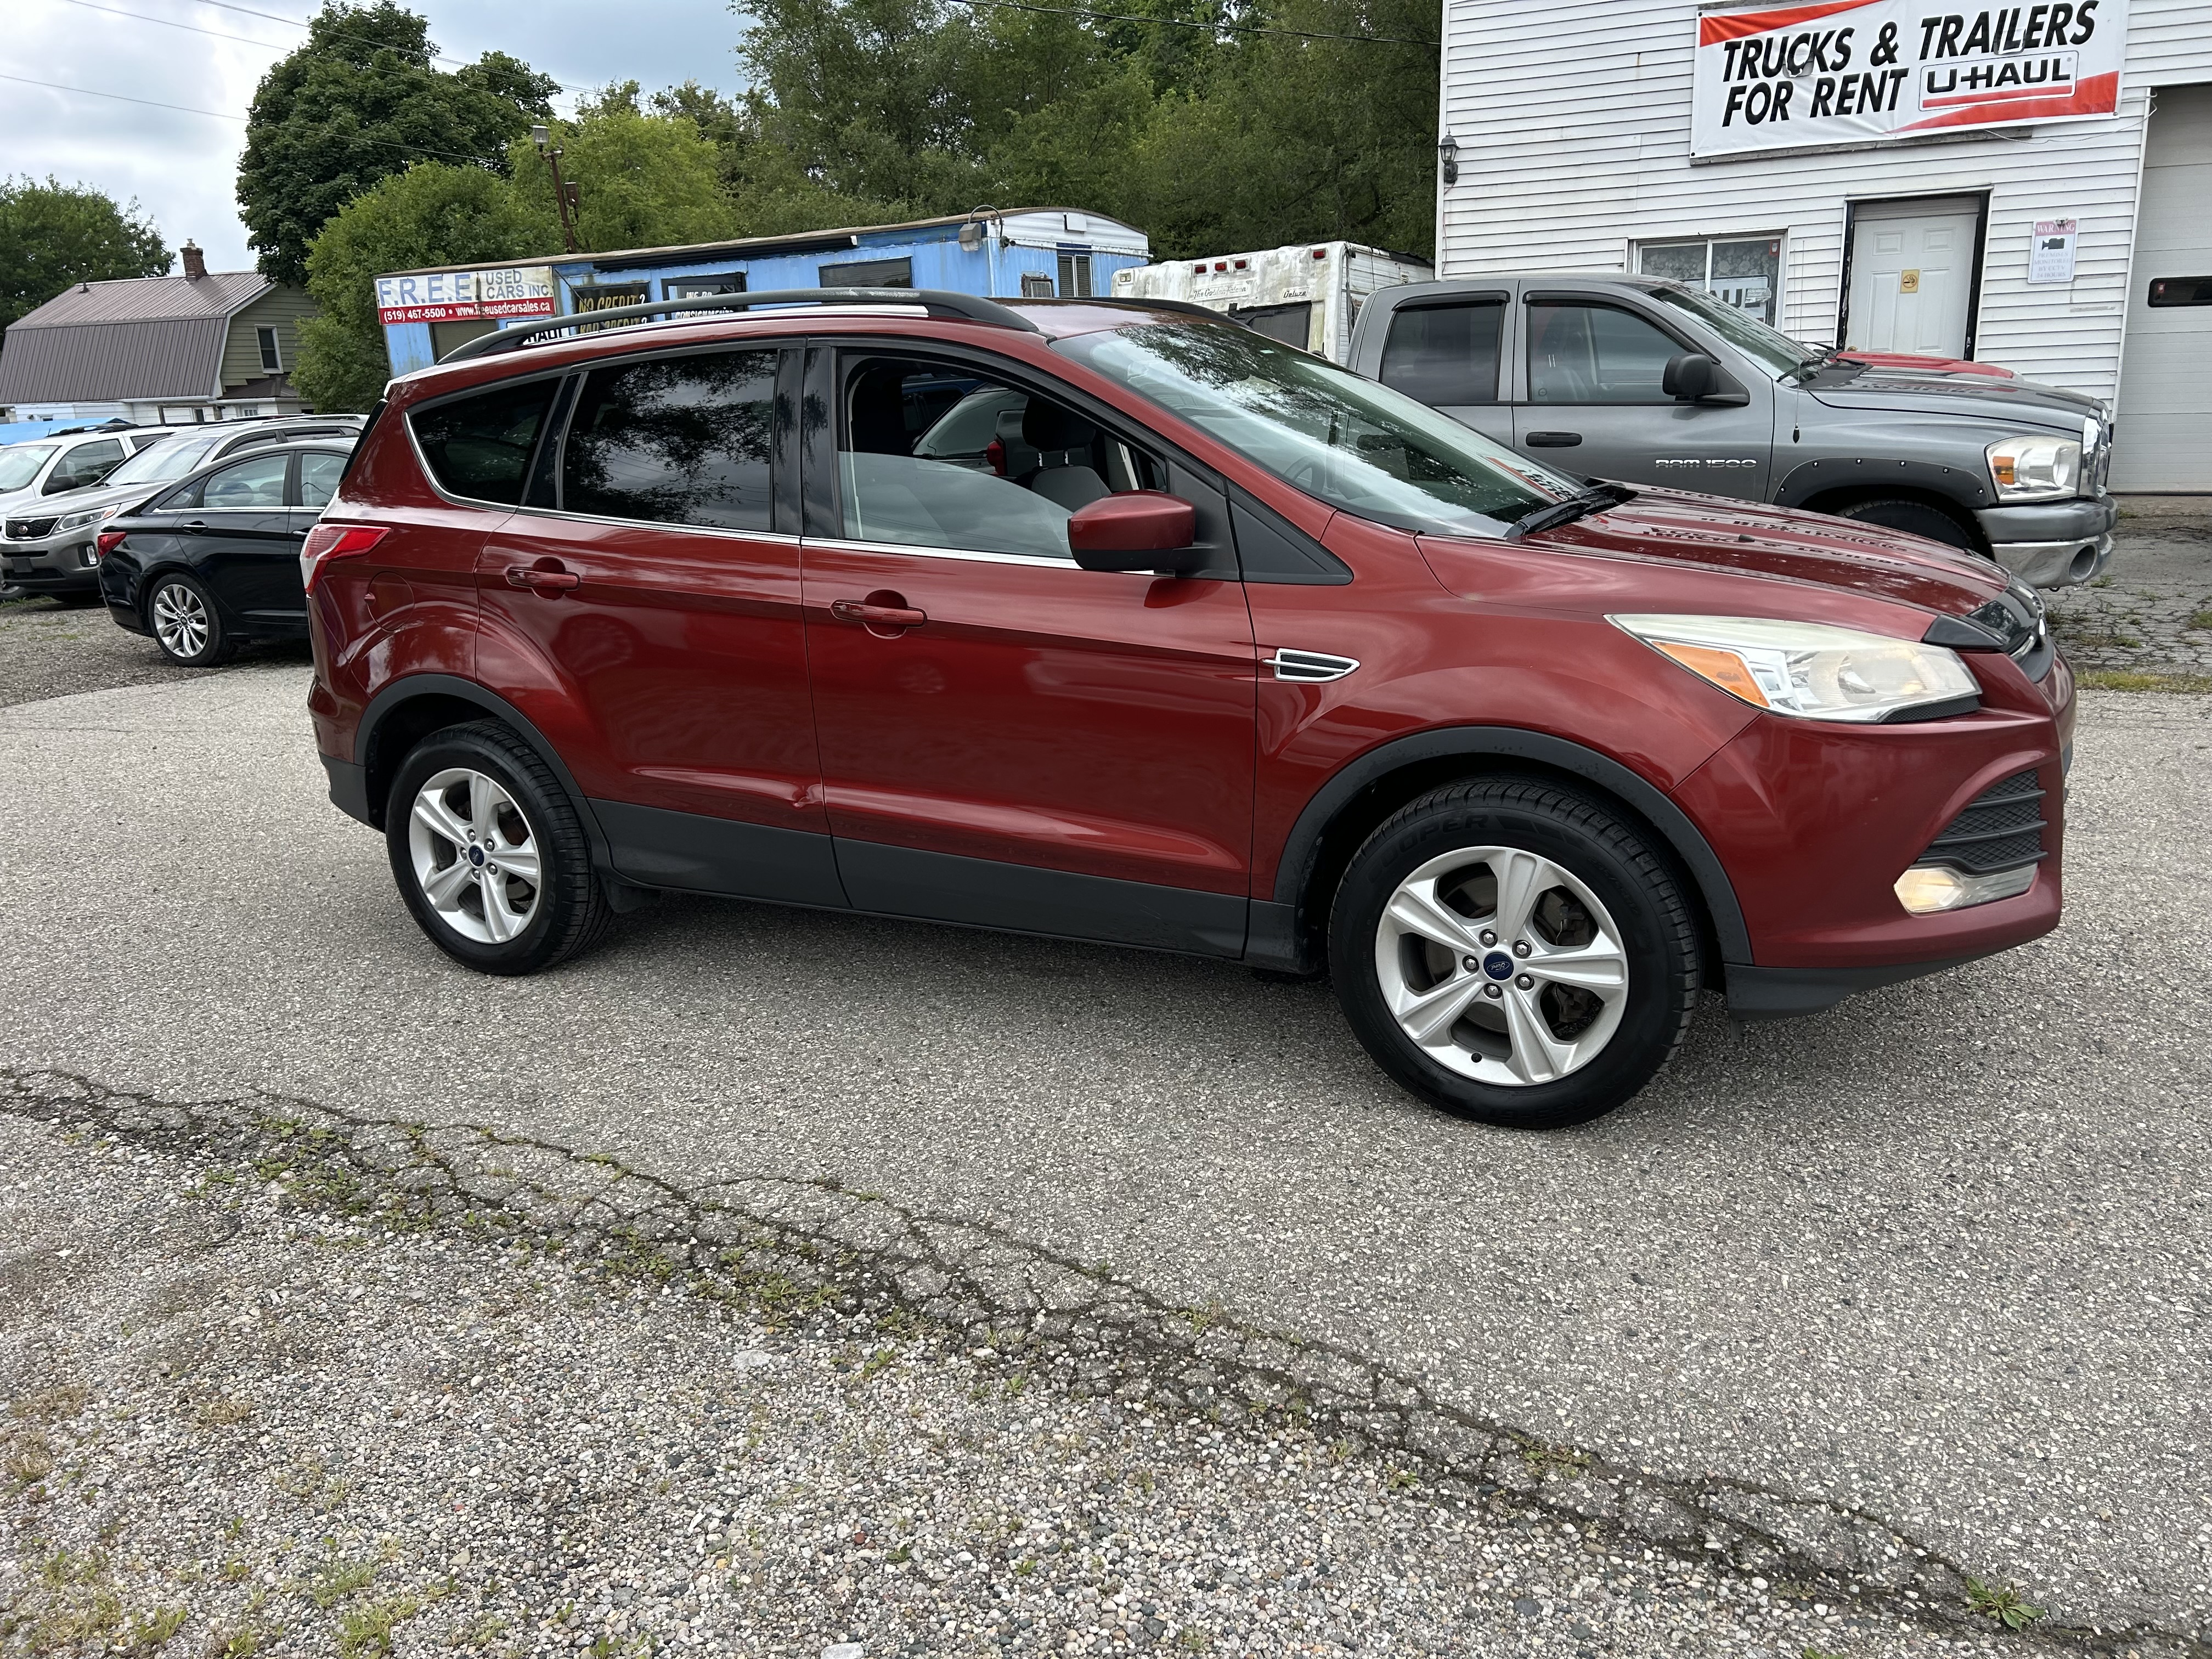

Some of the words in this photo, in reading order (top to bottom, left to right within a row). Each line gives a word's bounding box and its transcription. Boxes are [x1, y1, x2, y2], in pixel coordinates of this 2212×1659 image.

[1723, 27, 1855, 82] TRUCKS
[1870, 21, 1899, 67] &
[1919, 0, 2100, 60] TRAILERS
[1927, 58, 2071, 94] U-HAUL
[1722, 81, 1794, 127] FOR
[1810, 67, 1910, 118] RENT
[486, 270, 522, 285] USED
[487, 285, 524, 299] CARS
[529, 284, 553, 297] INC.
[1283, 290, 1306, 298] Deluxe
[384, 309, 405, 323] (519)
[407, 307, 446, 319] 467-5500
[1656, 459, 1700, 468] RAM
[1706, 459, 1757, 468] 1500
